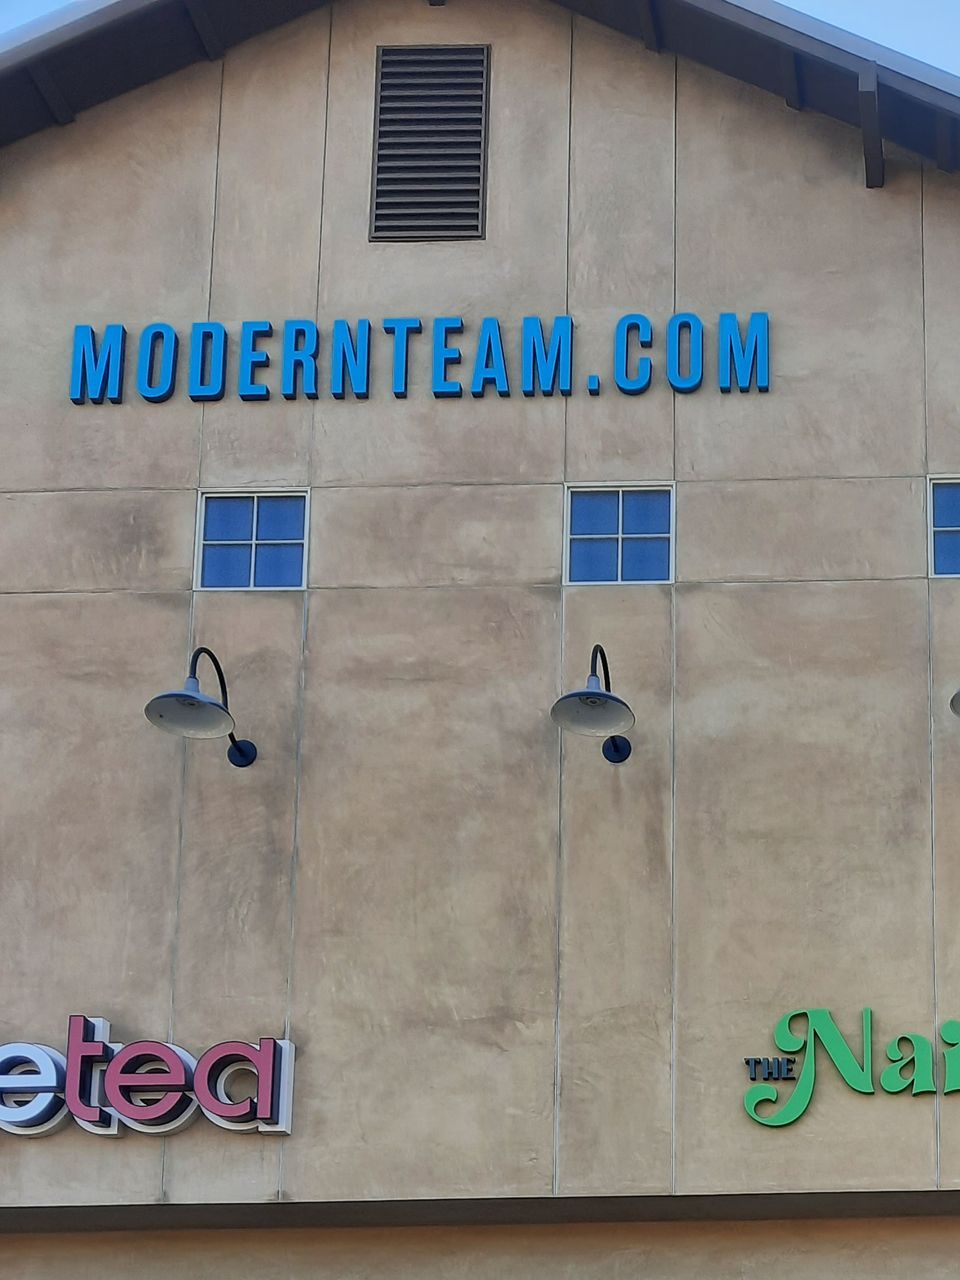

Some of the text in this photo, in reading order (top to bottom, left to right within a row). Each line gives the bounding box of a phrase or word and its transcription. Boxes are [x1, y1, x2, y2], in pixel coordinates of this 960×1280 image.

[70, 312, 771, 404] MODERNTEAM.COM
[0, 1015, 294, 1134] etea
[744, 1056, 796, 1082] THE
